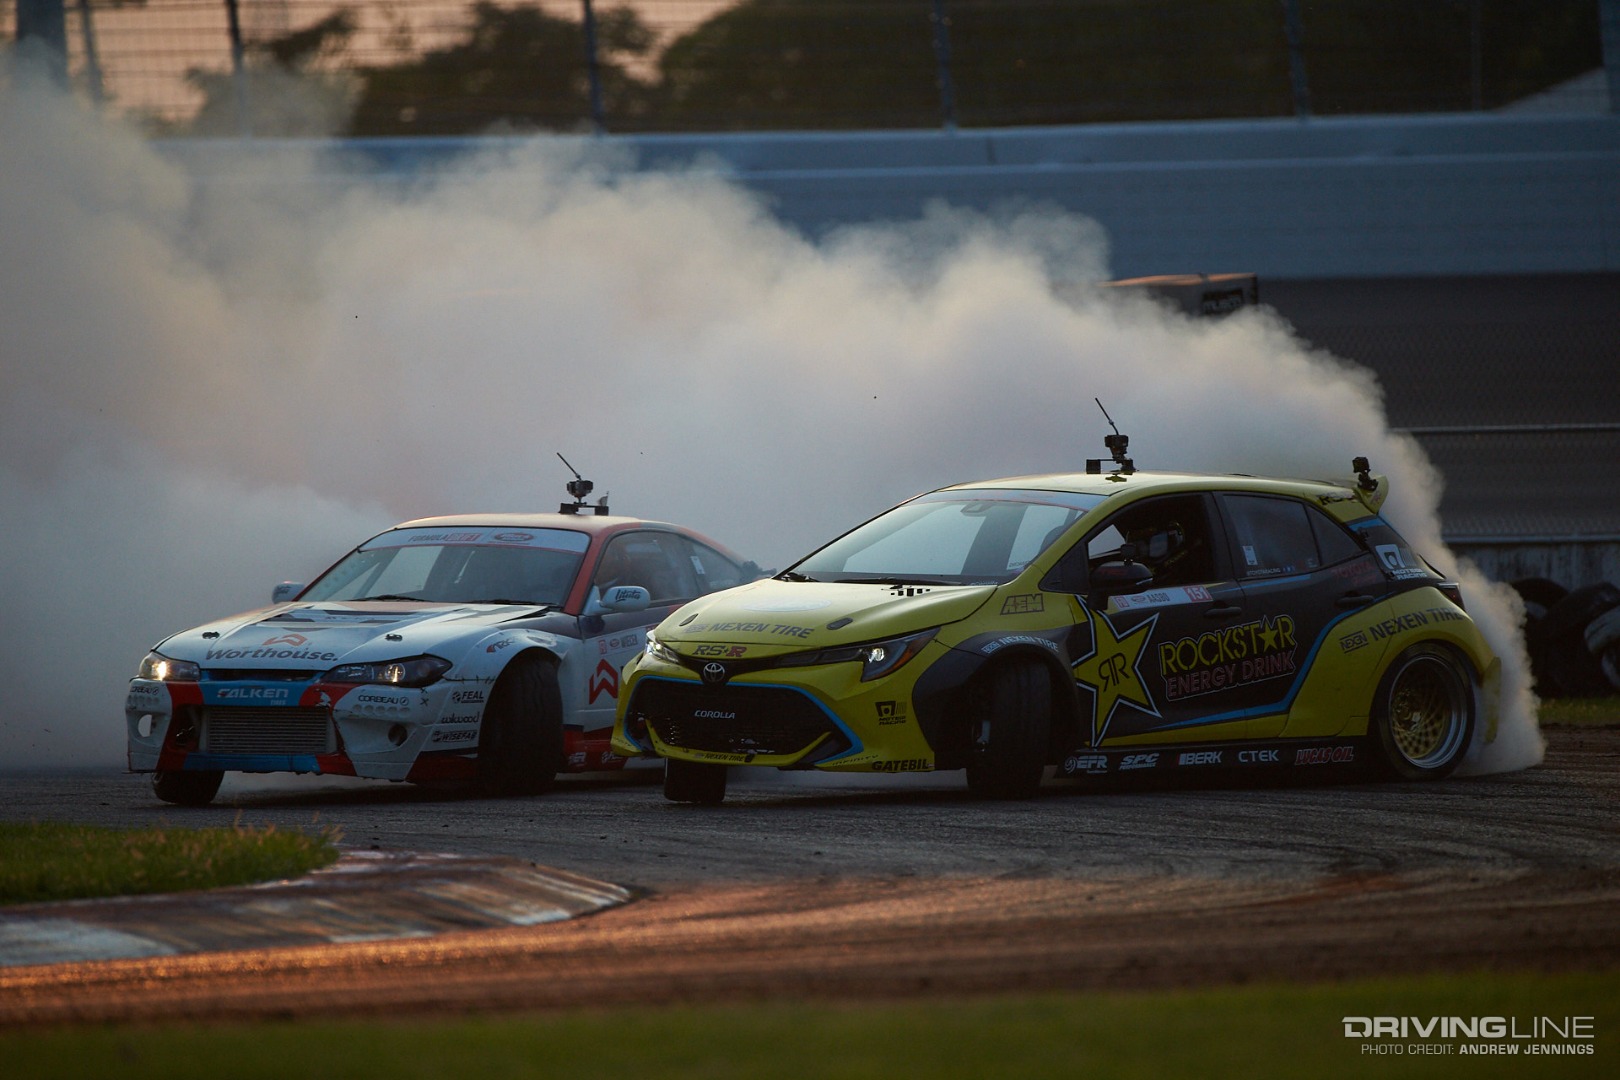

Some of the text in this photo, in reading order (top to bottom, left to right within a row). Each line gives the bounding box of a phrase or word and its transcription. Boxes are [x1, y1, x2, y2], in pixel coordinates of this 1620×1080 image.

[1187, 587, 1210, 601] 151
[1000, 593, 1044, 615] AEM
[709, 622, 770, 632] NEXEN
[771, 624, 815, 639] TIRE
[1369, 611, 1428, 641] NEXEN
[998, 635, 1060, 654] NEXEN TIRE
[1167, 650, 1294, 697] ENERGY DRINK
[217, 688, 289, 698] FALKEN
[358, 695, 399, 704] CORBEAU
[462, 691, 484, 700] FEAL
[694, 710, 736, 719] COROLLA
[704, 753, 728, 761] NEXEN
[1076, 755, 1108, 769] EFR
[1121, 753, 1160, 765] SPC
[1186, 751, 1223, 765] BERK
[1238, 749, 1279, 763] CTEK
[1295, 746, 1354, 765] LUCAS OIL
[872, 758, 930, 771] GATEBIL
